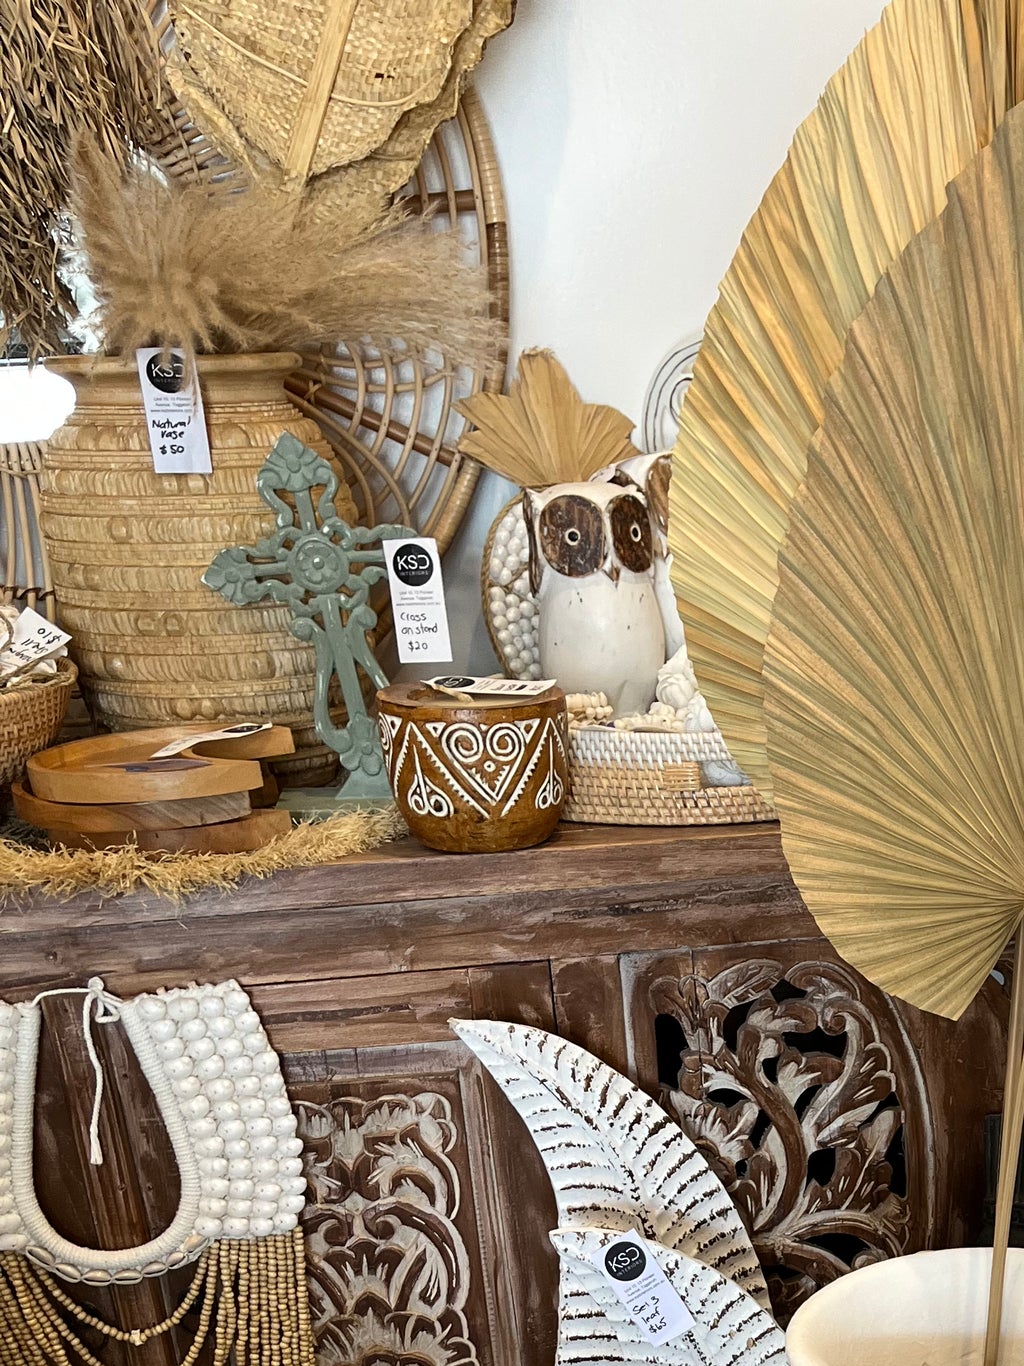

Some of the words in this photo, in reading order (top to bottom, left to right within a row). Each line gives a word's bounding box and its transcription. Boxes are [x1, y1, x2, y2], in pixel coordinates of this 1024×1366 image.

[152, 415, 191, 429] Natural
[397, 554, 430, 570] KSD
[400, 611, 427, 622] Cross
[37, 627, 62, 645] $10
[408, 641, 429, 652] $20
[608, 1246, 640, 1273] KSD
[649, 1316, 667, 1334] $65
